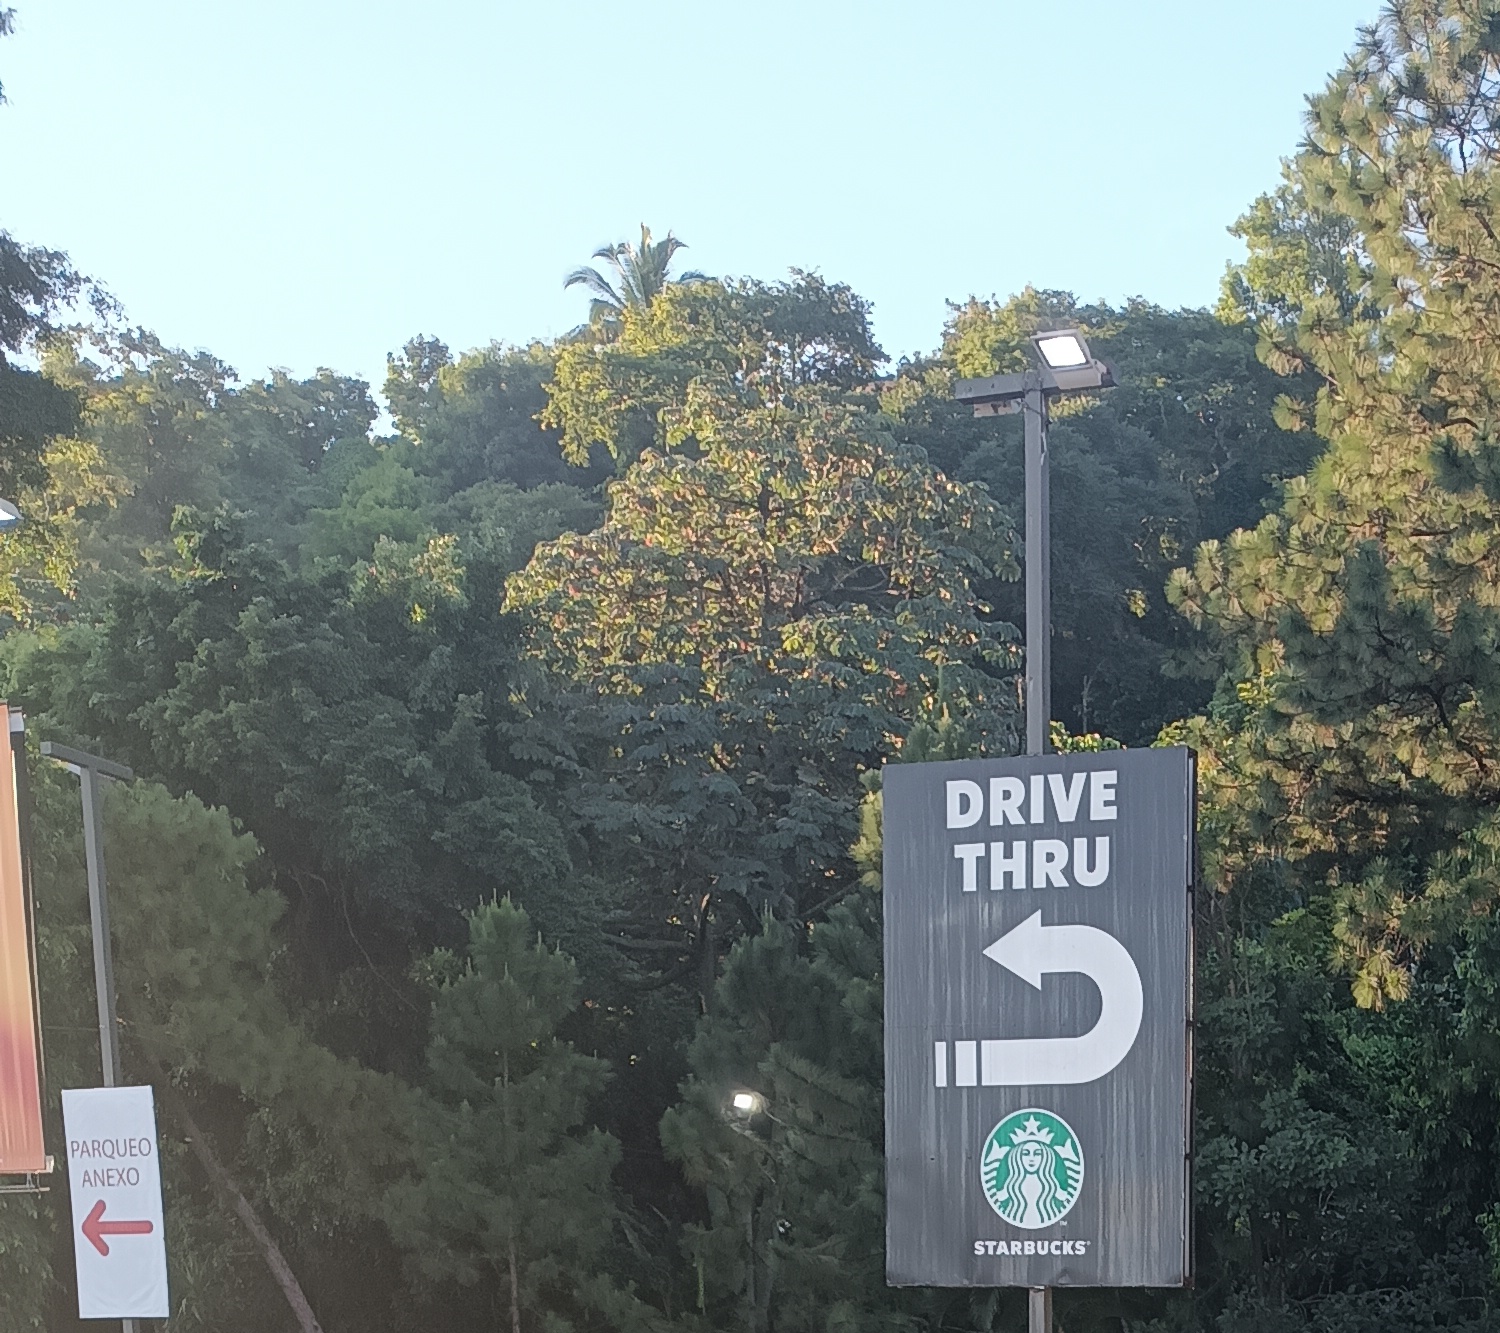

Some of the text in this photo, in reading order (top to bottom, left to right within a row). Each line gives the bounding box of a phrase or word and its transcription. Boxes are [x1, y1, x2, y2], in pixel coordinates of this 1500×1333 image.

[946, 770, 1118, 829] DRIVE
[954, 836, 1110, 892] THRU
[71, 1138, 152, 1159] PARQUEO
[82, 1167, 140, 1188] ANEXO
